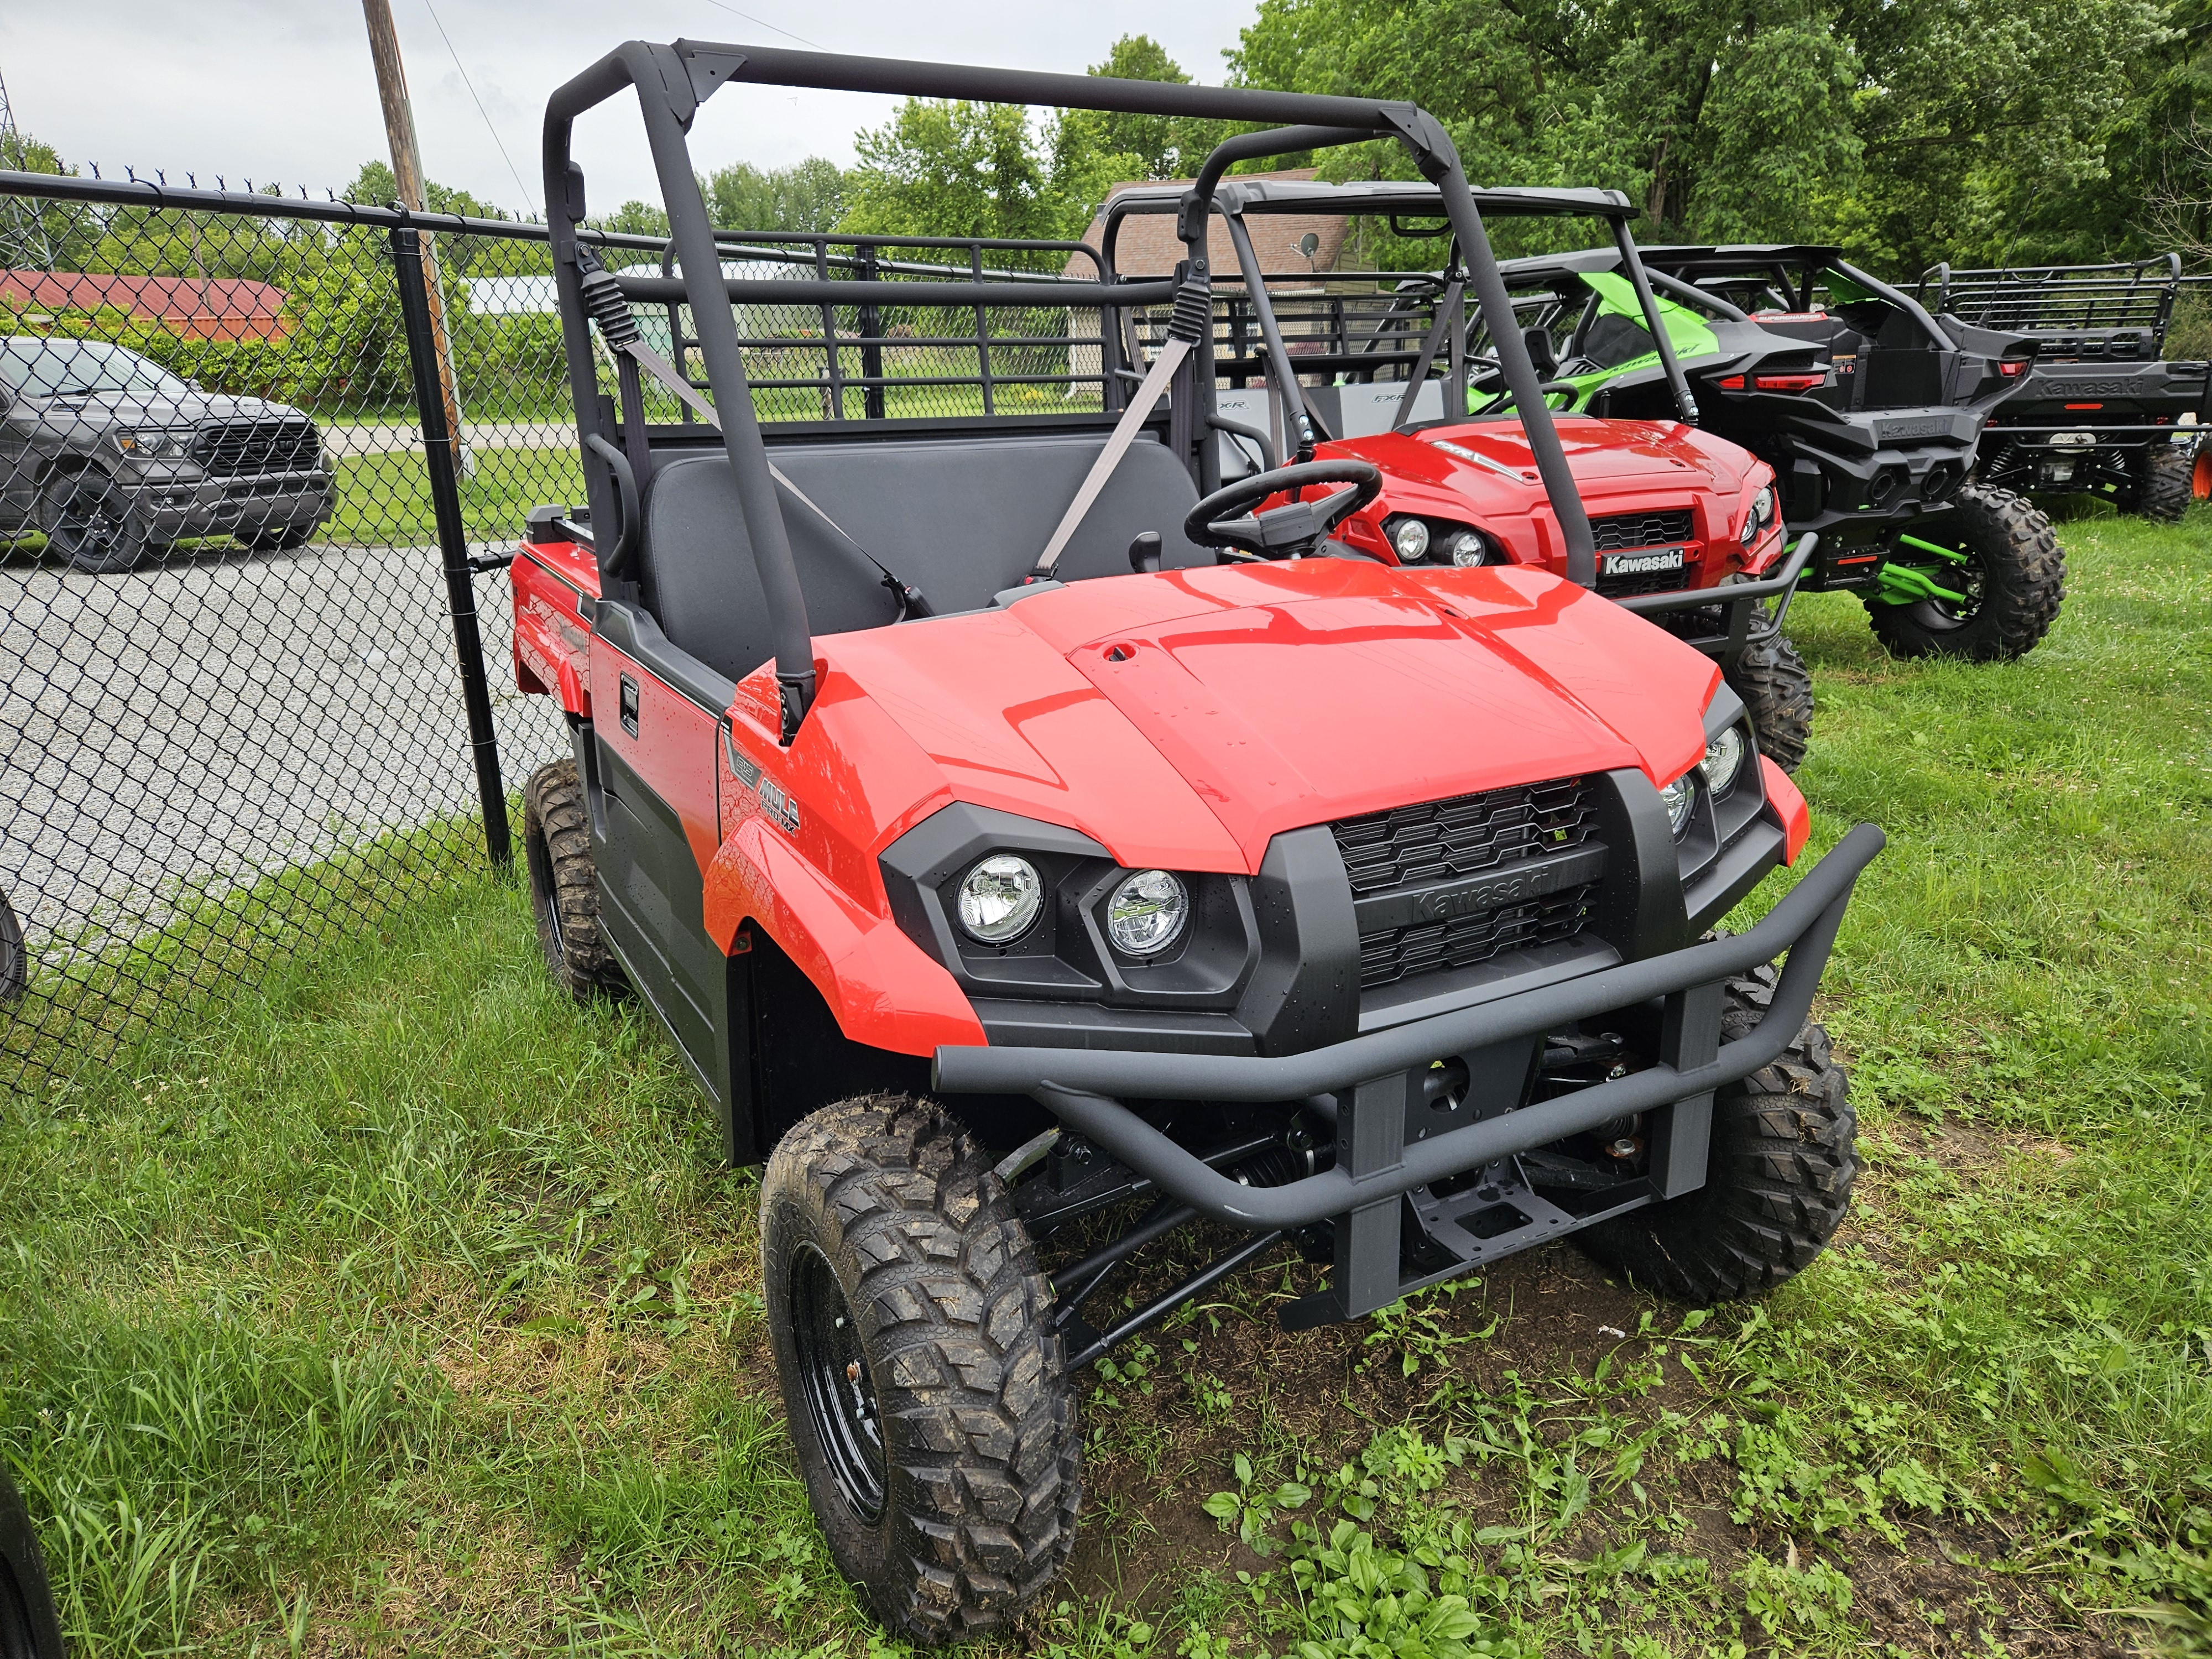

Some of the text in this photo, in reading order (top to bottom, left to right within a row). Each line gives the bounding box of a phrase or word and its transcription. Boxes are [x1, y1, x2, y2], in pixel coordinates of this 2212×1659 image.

[1607, 344, 1699, 374] Kawaki
[2036, 378, 2144, 397] Kawasaki
[1217, 400, 1249, 410] XR
[1881, 419, 1948, 438] Kawasaki
[1605, 550, 1683, 575] Kawasaki
[758, 777, 801, 830] MULE
[761, 800, 796, 838] PRO-MX
[1411, 865, 1548, 922] Kawasaki
